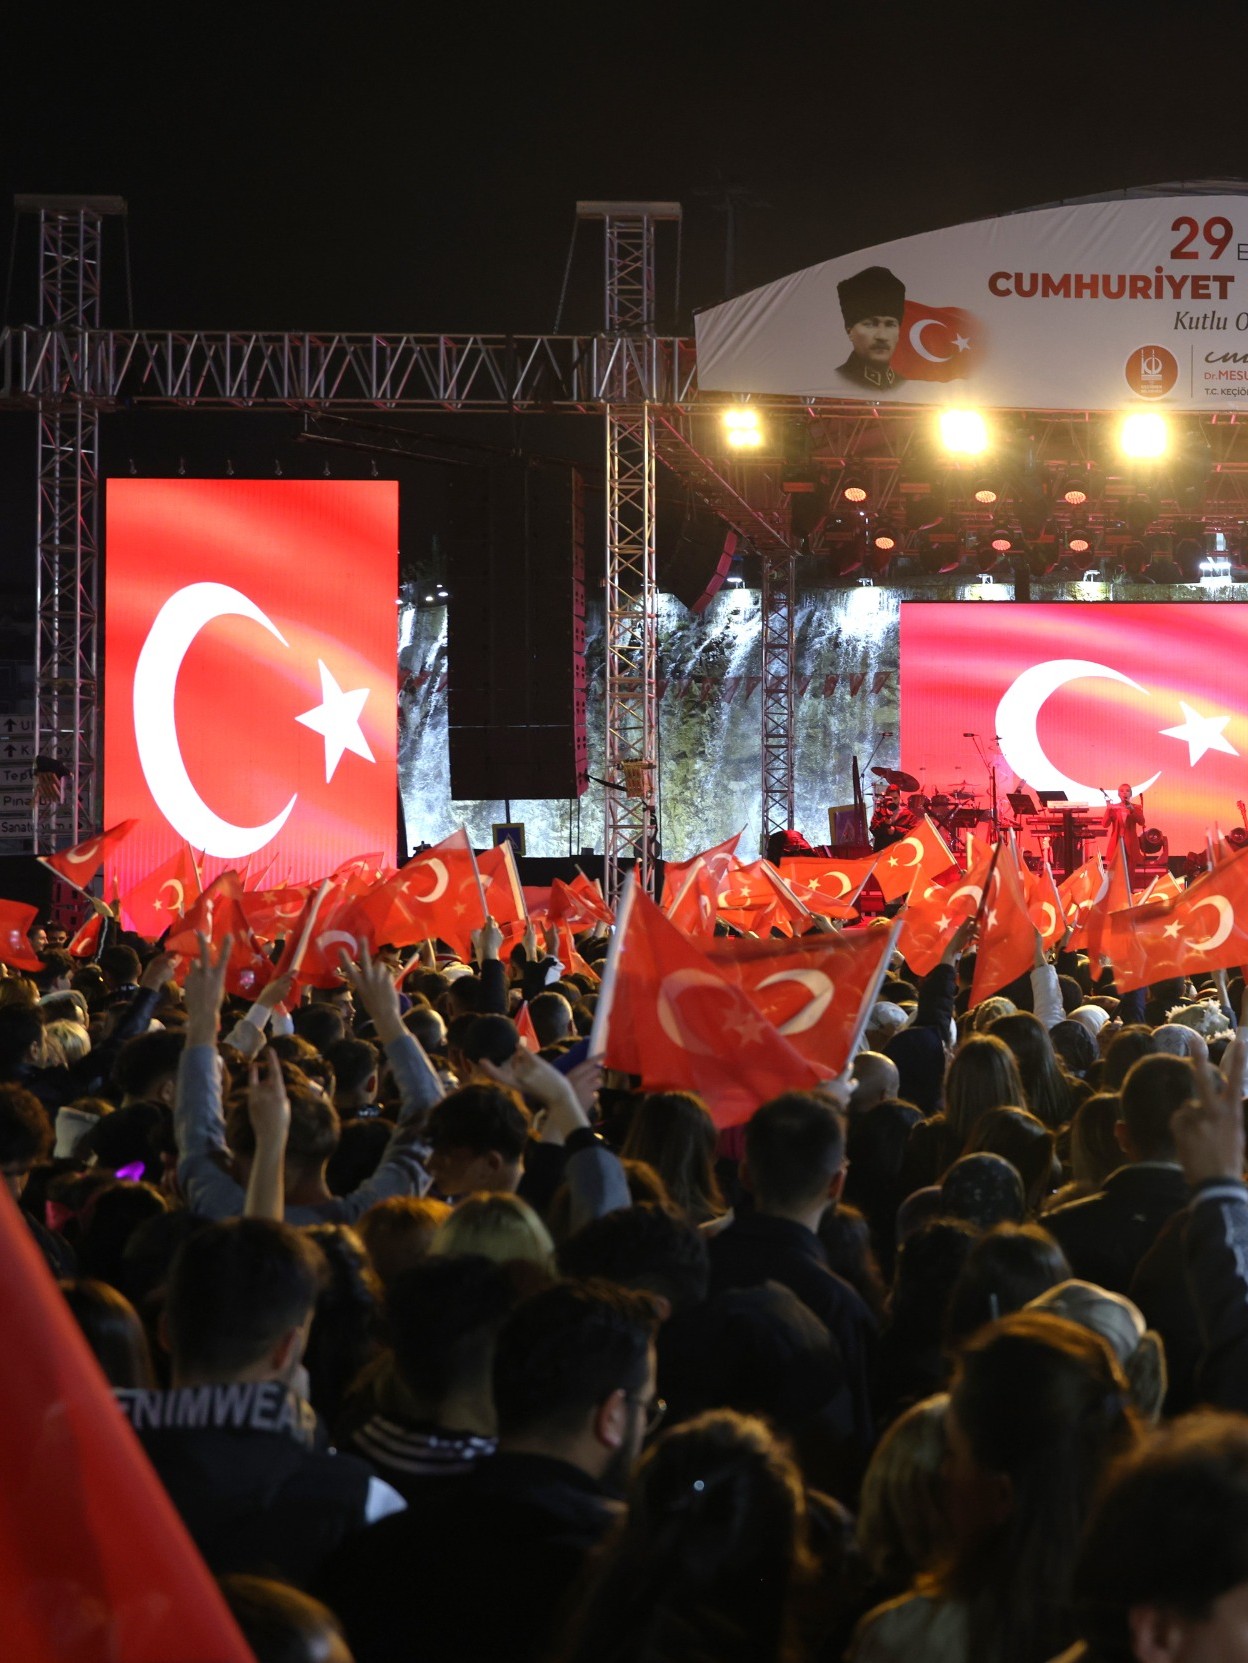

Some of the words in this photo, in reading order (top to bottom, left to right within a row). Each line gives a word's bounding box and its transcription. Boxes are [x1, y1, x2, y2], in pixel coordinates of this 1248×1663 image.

[1170, 216, 1234, 260] 29
[988, 265, 1235, 300] CUMHURİYET
[1173, 310, 1228, 330] Kutlu
[1204, 388, 1219, 396] T.C.
